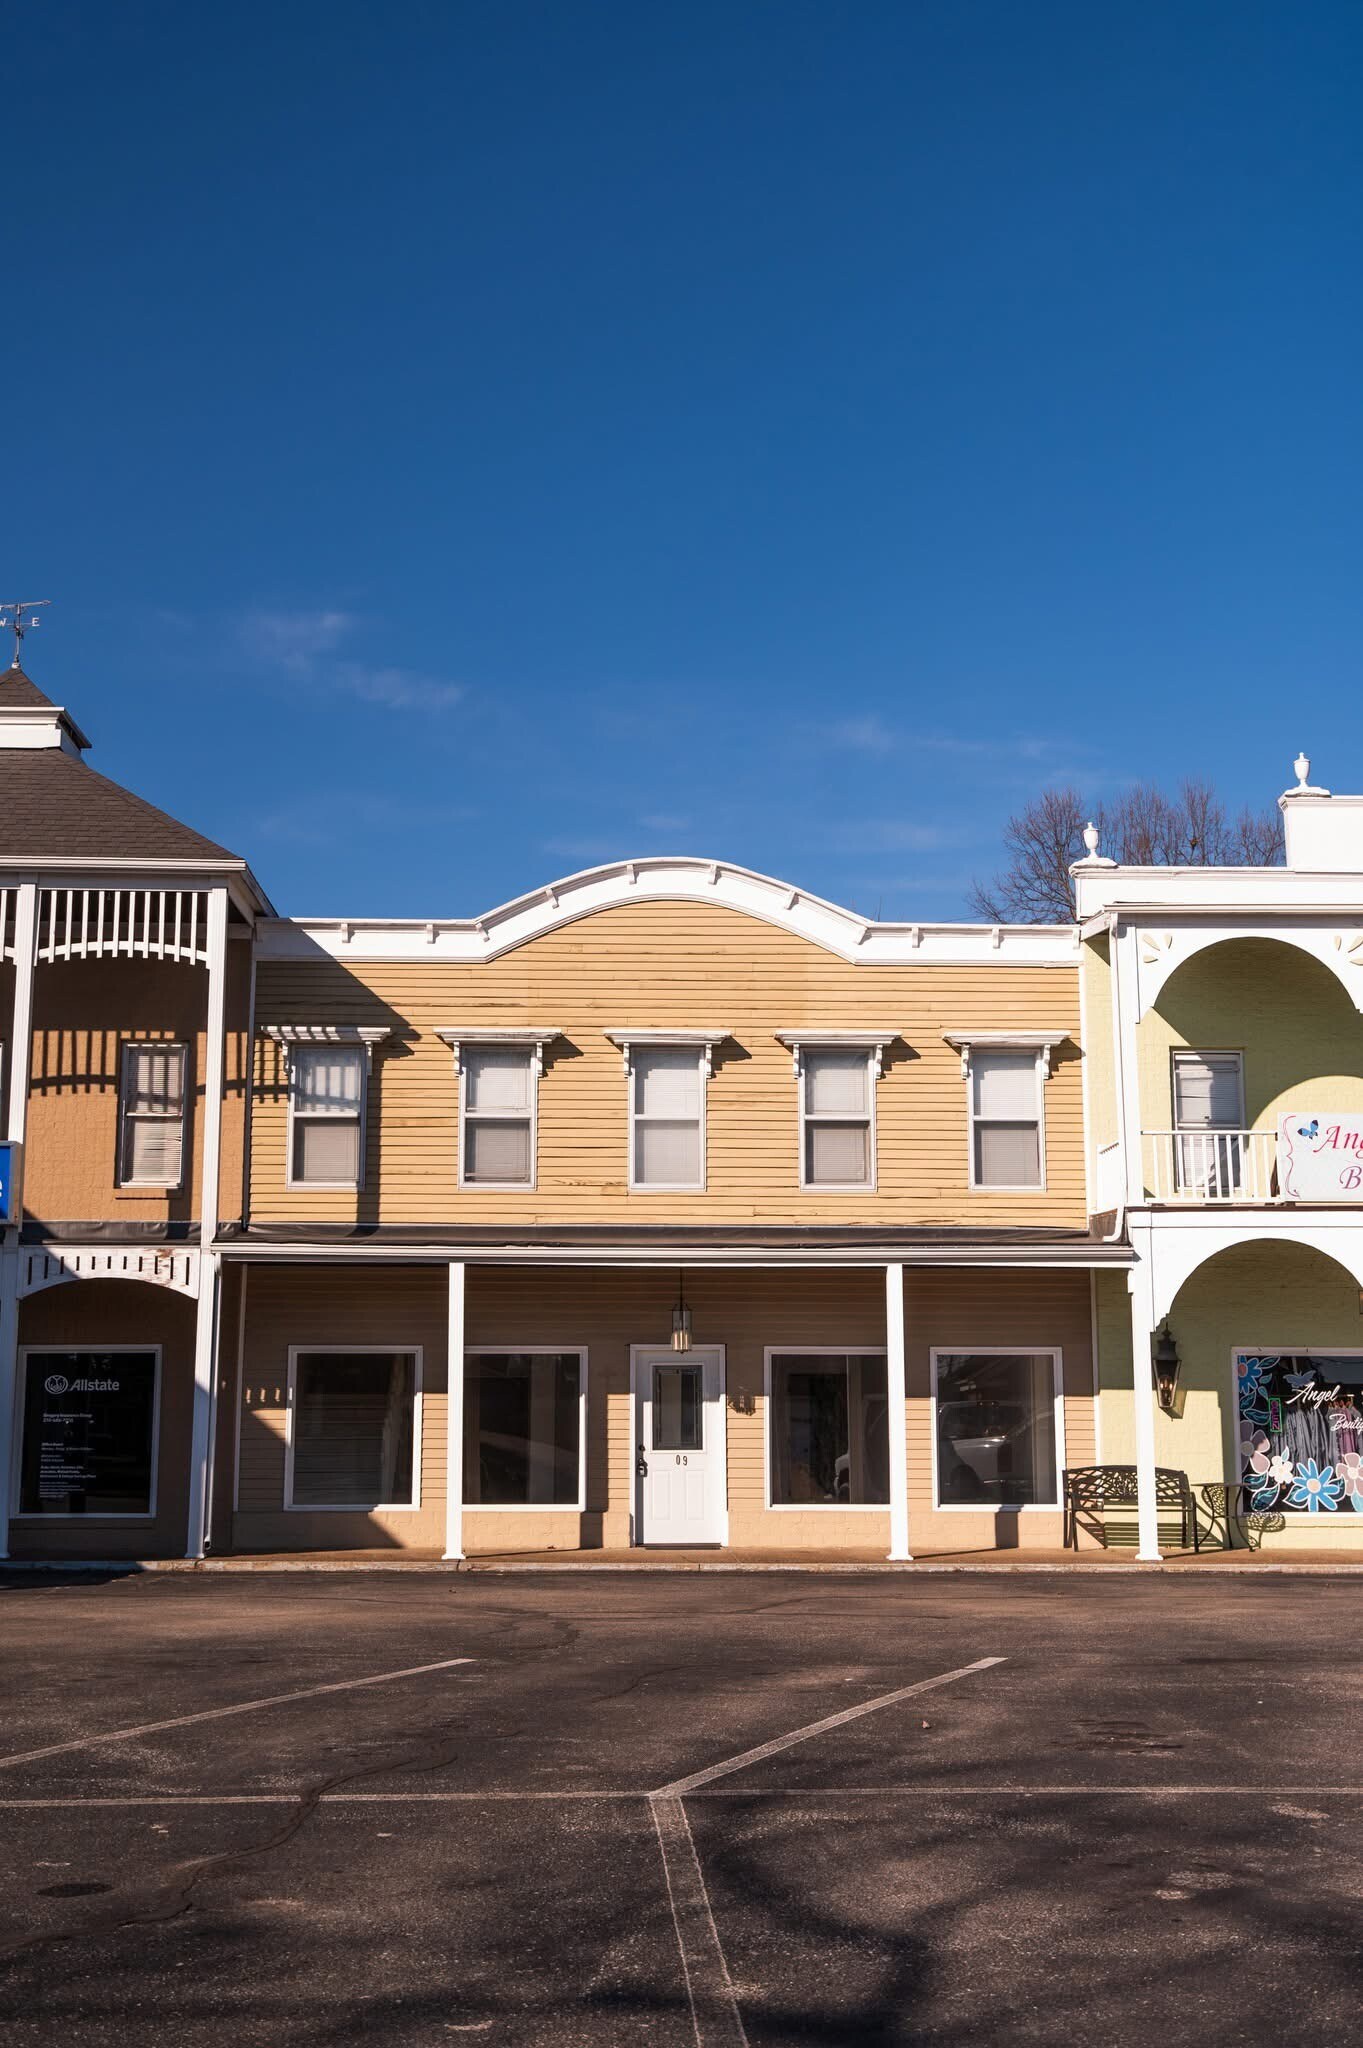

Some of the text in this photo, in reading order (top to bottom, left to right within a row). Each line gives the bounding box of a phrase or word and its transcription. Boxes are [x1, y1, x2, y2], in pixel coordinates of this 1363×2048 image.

[31, 617, 40, 627] E
[69, 1379, 120, 1391] Allstate
[1285, 1381, 1341, 1410] Angel
[675, 1454, 688, 1466] 09
